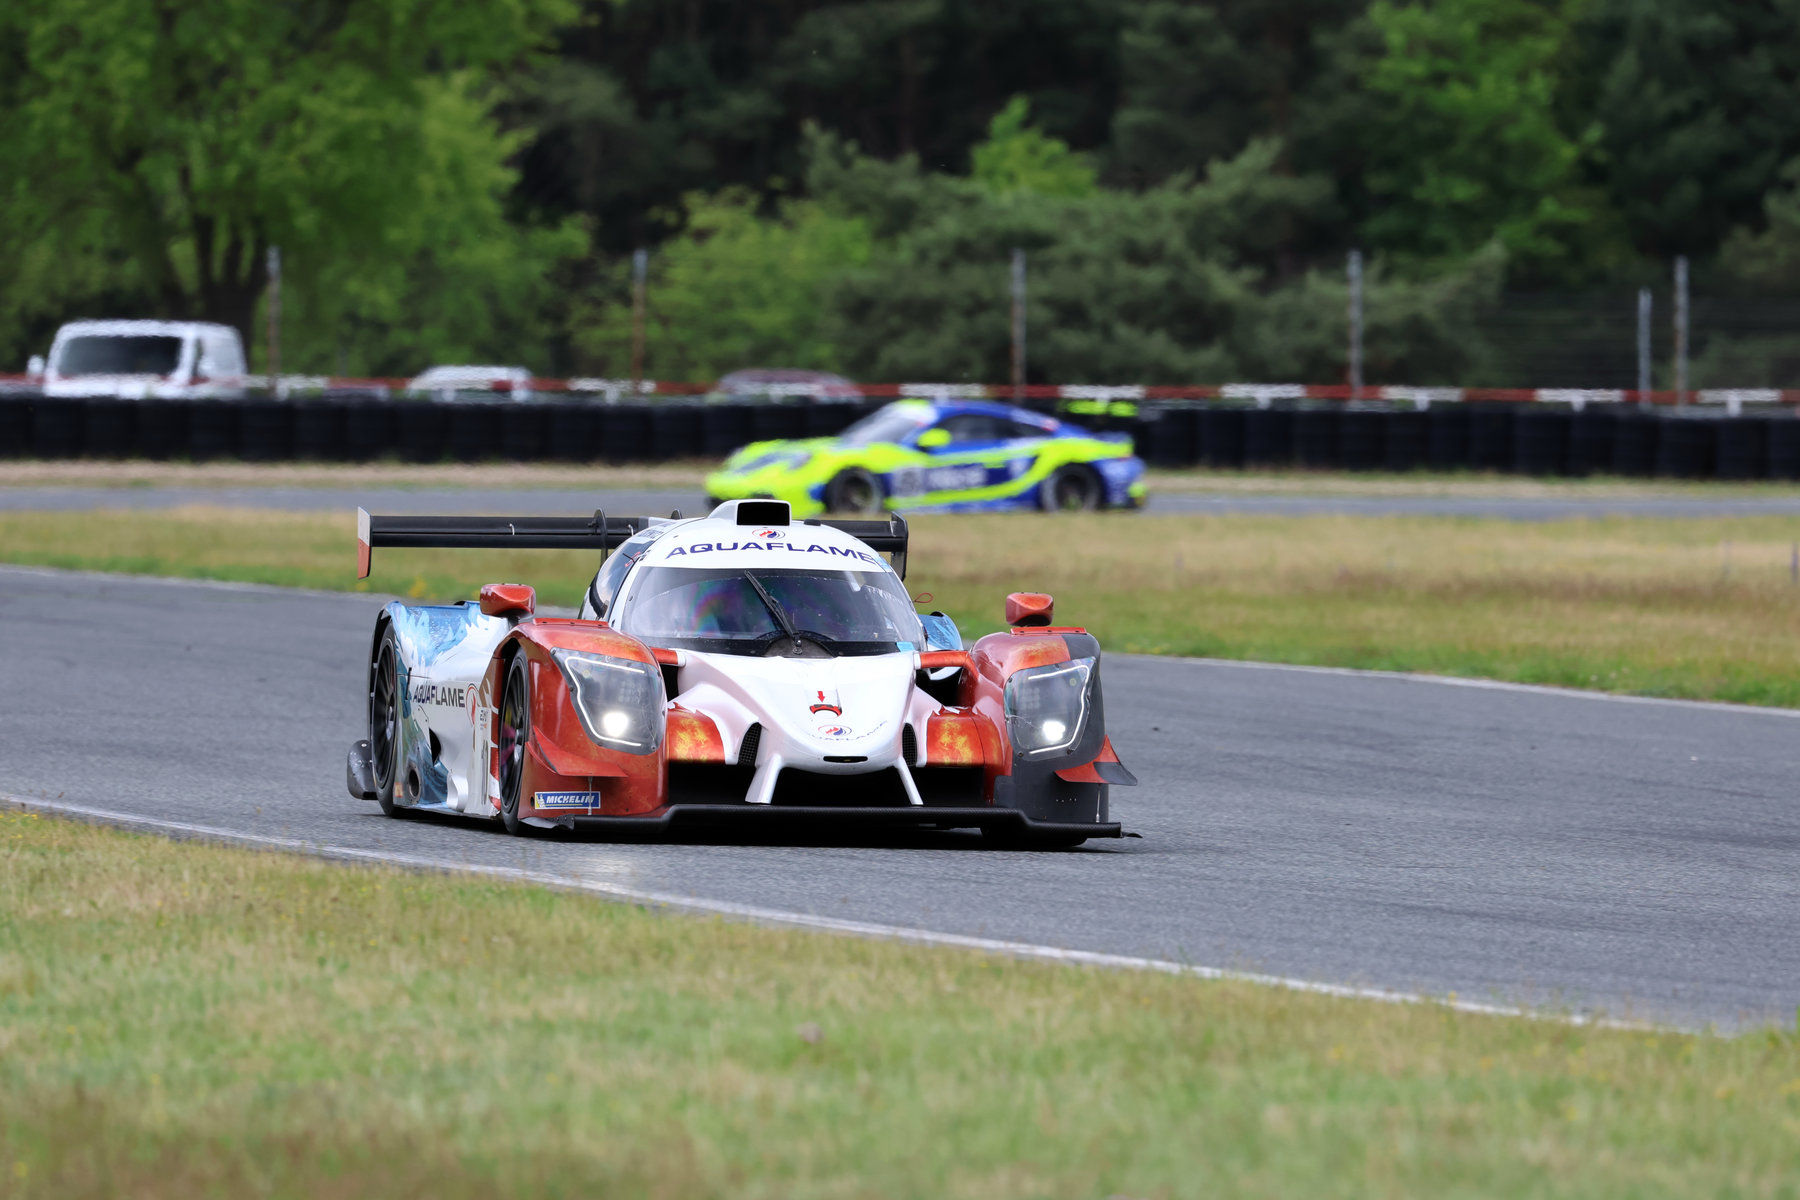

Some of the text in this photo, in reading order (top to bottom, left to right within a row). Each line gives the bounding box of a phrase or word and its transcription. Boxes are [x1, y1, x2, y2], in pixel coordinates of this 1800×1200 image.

[665, 542, 876, 565] AQUAFLAME
[412, 684, 466, 708] AQUAFLAME
[546, 795, 595, 804] MICHELIN
